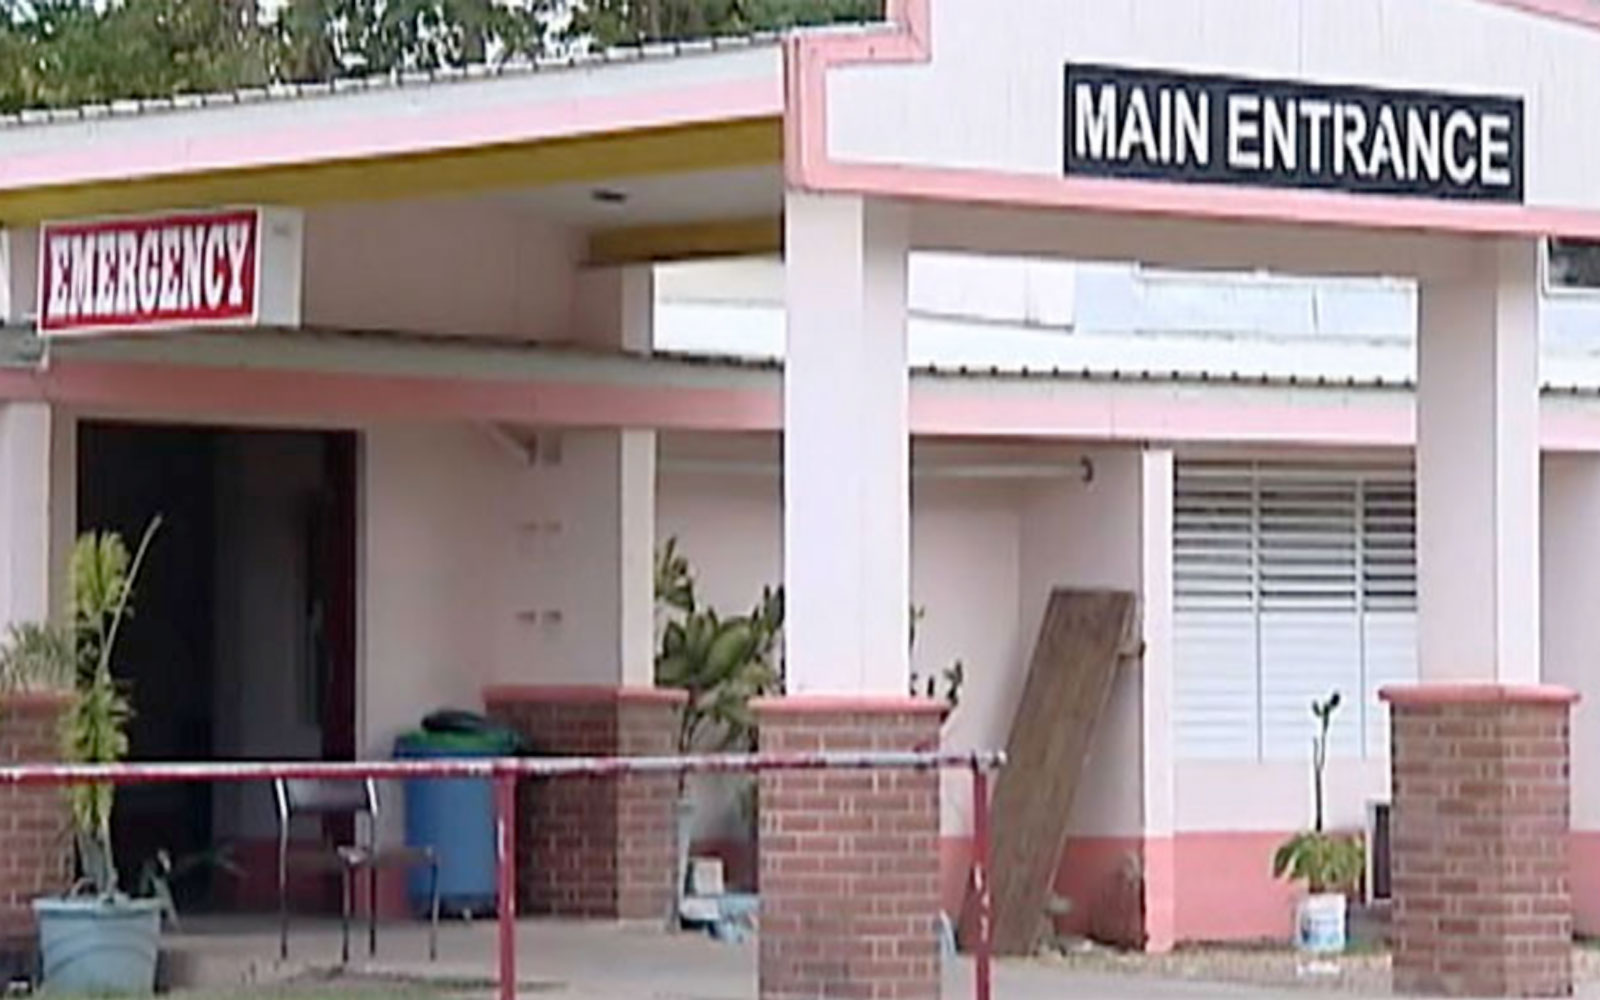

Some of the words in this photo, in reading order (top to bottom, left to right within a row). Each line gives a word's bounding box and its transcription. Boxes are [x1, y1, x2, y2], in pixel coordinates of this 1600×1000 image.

[1075, 83, 1209, 165] MAIN
[1228, 94, 1511, 186] ENTRANCE
[47, 221, 250, 318] EMERGENCY
